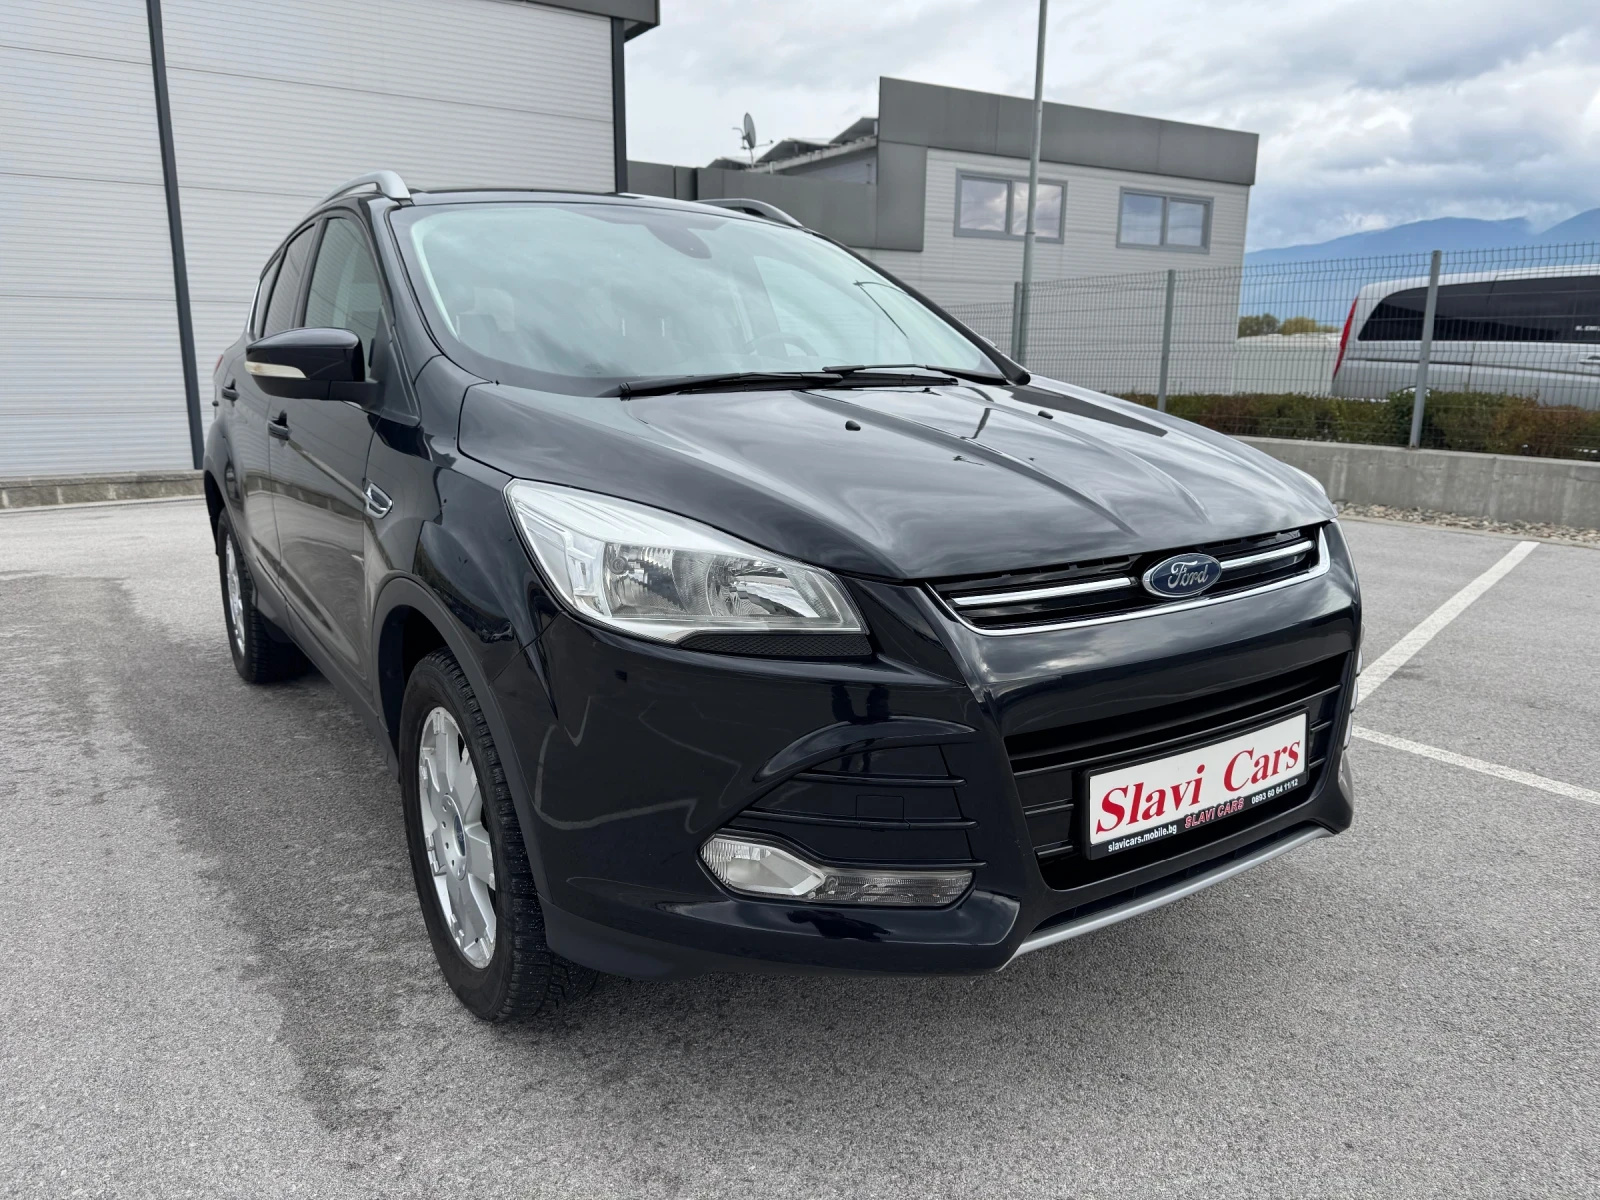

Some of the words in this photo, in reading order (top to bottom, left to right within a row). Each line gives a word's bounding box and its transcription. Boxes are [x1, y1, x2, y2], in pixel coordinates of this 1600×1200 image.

[1167, 561, 1209, 589] Ford
[1096, 764, 1206, 835] Slavi
[1223, 740, 1300, 792] Cars
[1108, 824, 1177, 852] slavicars.mobile.bg
[1184, 807, 1215, 829] SLAVI
[1217, 797, 1245, 818] CARS
[1251, 792, 1267, 804] 0893
